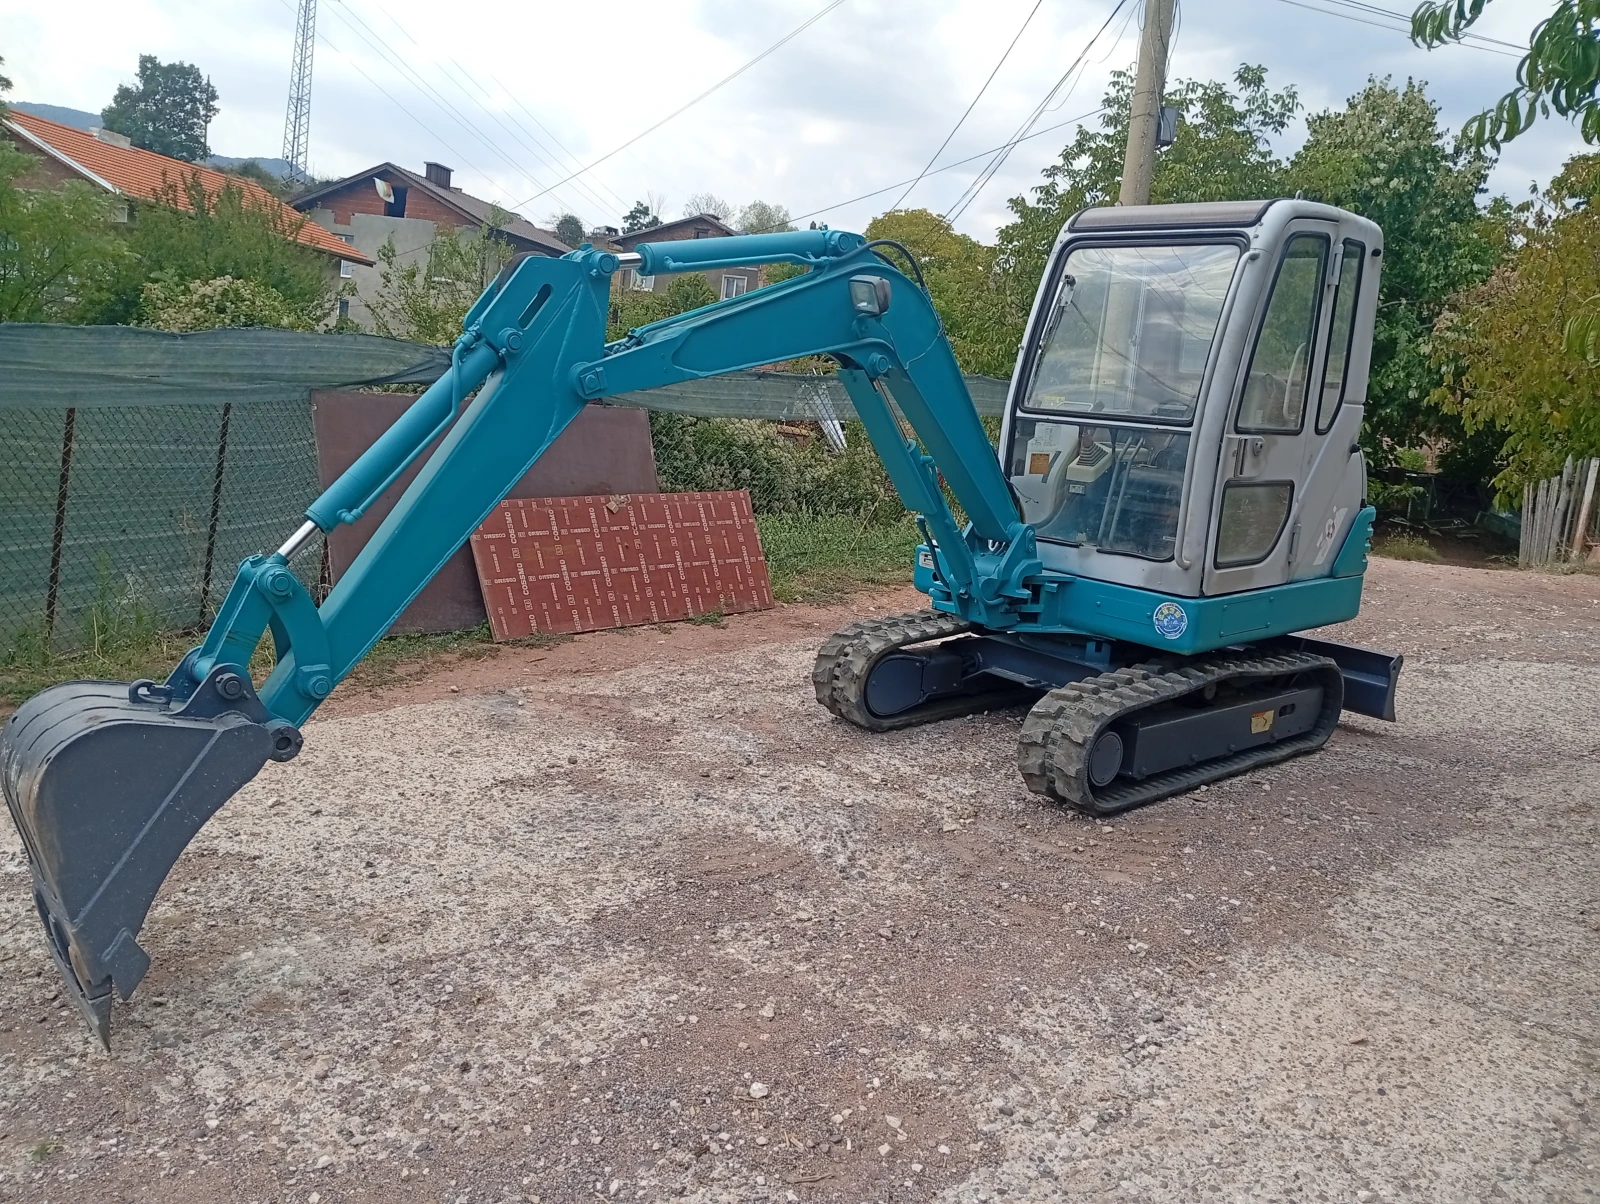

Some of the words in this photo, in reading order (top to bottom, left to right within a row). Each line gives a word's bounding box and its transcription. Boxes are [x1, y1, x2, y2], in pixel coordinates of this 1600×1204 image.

[505, 512, 517, 543] COSSMO
[548, 509, 560, 540] COSSMO
[589, 507, 600, 538] COSSMO
[664, 504, 674, 533] COSSMO
[698, 503, 708, 531] COSSMO
[730, 502, 741, 529] COSSMO
[560, 559, 571, 591] COSSMO
[600, 556, 612, 587] COSSMO
[639, 553, 650, 583] COSSMO
[675, 551, 685, 580] COSSMO
[709, 548, 719, 577] COSSMO
[742, 546, 752, 574] COSSMO
[517, 563, 529, 595] COSSMO
